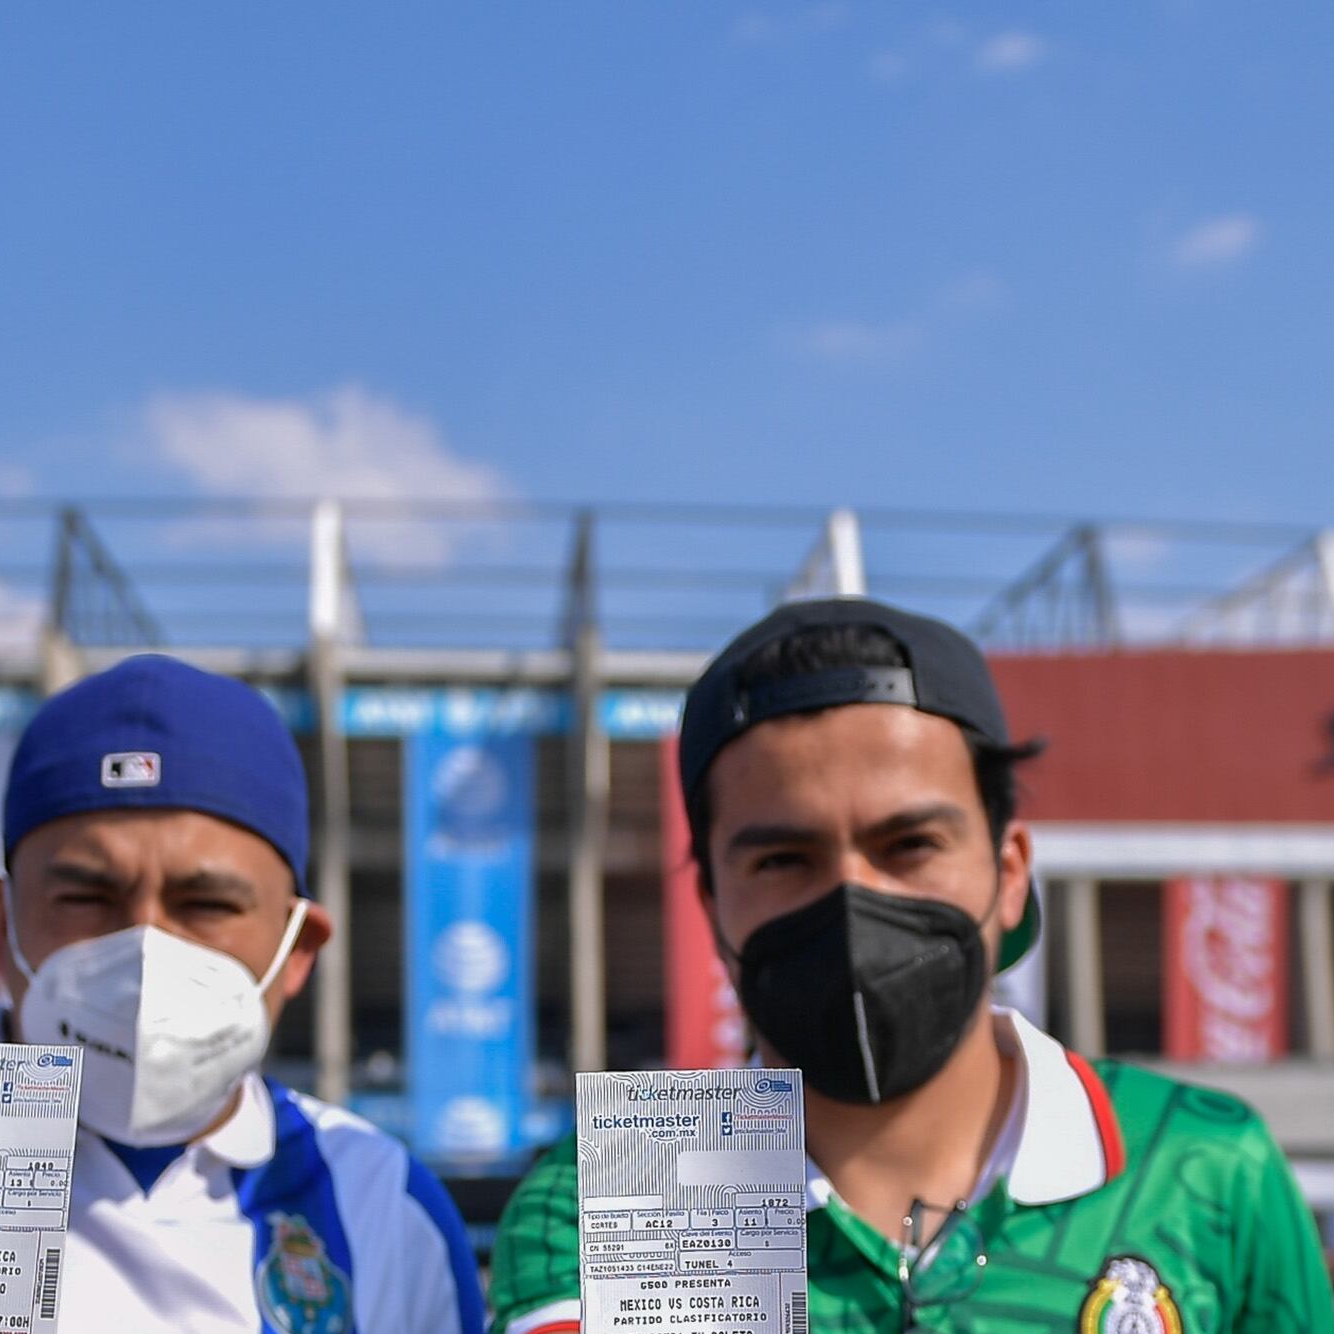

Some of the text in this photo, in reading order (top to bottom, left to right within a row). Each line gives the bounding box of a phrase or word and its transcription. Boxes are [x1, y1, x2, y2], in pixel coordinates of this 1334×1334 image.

[626, 1084, 742, 1102] ticketmaster
[593, 1113, 700, 1130] ticketmaster
[648, 1128, 697, 1138] .com.mx
[11, 1178, 23, 1187] 13
[762, 1199, 789, 1208] 1872
[645, 1220, 673, 1229] AC12
[712, 1218, 719, 1227] 3
[743, 1218, 757, 1226] 11
[681, 1238, 731, 1249] EAZ0130
[685, 1260, 733, 1269] TUNEL 4
[640, 1278, 731, 1290] G500 PRESENTA
[619, 1296, 760, 1312] MEXICO VS COSTA RICA
[613, 1312, 767, 1326] PARTIDO CLASIFICATORIO
